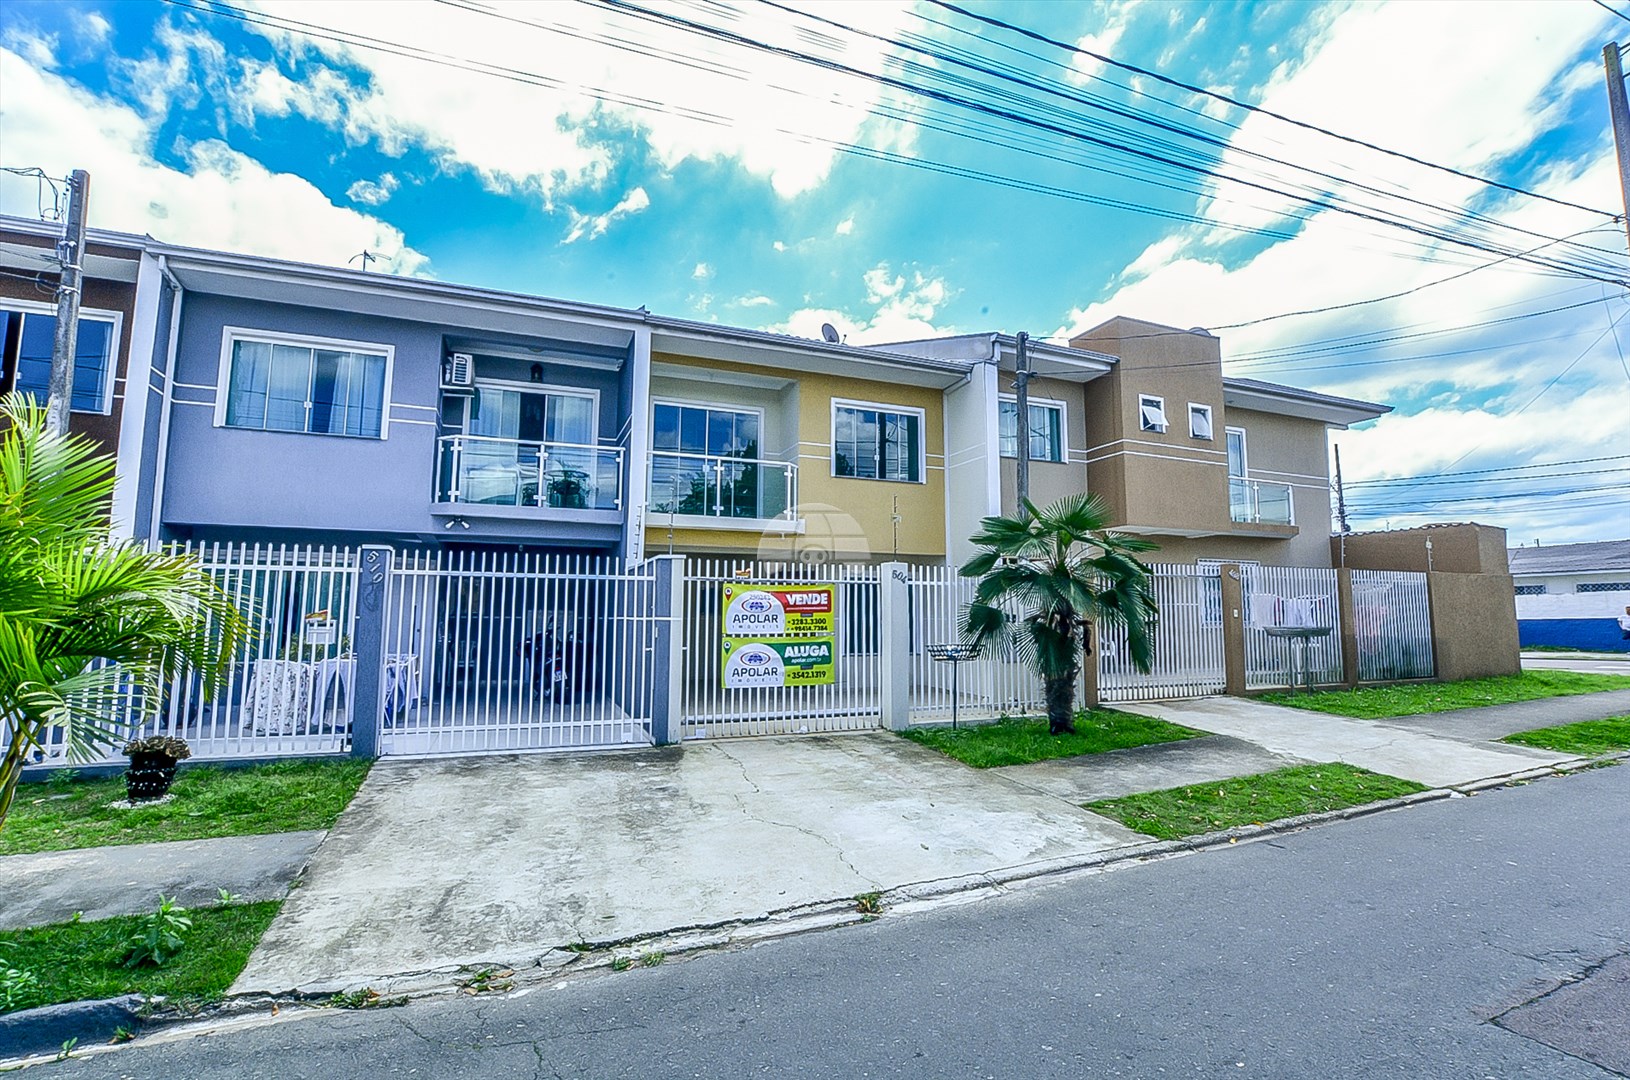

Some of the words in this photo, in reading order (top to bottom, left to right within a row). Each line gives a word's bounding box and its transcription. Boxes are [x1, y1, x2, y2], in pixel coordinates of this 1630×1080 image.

[367, 551, 384, 583] 510
[785, 593, 828, 605] VENDE
[732, 614, 778, 623] APOLAR
[784, 645, 829, 658] ALUGA
[731, 667, 778, 677] APOLAR
[791, 671, 827, 679] 3542.1319
